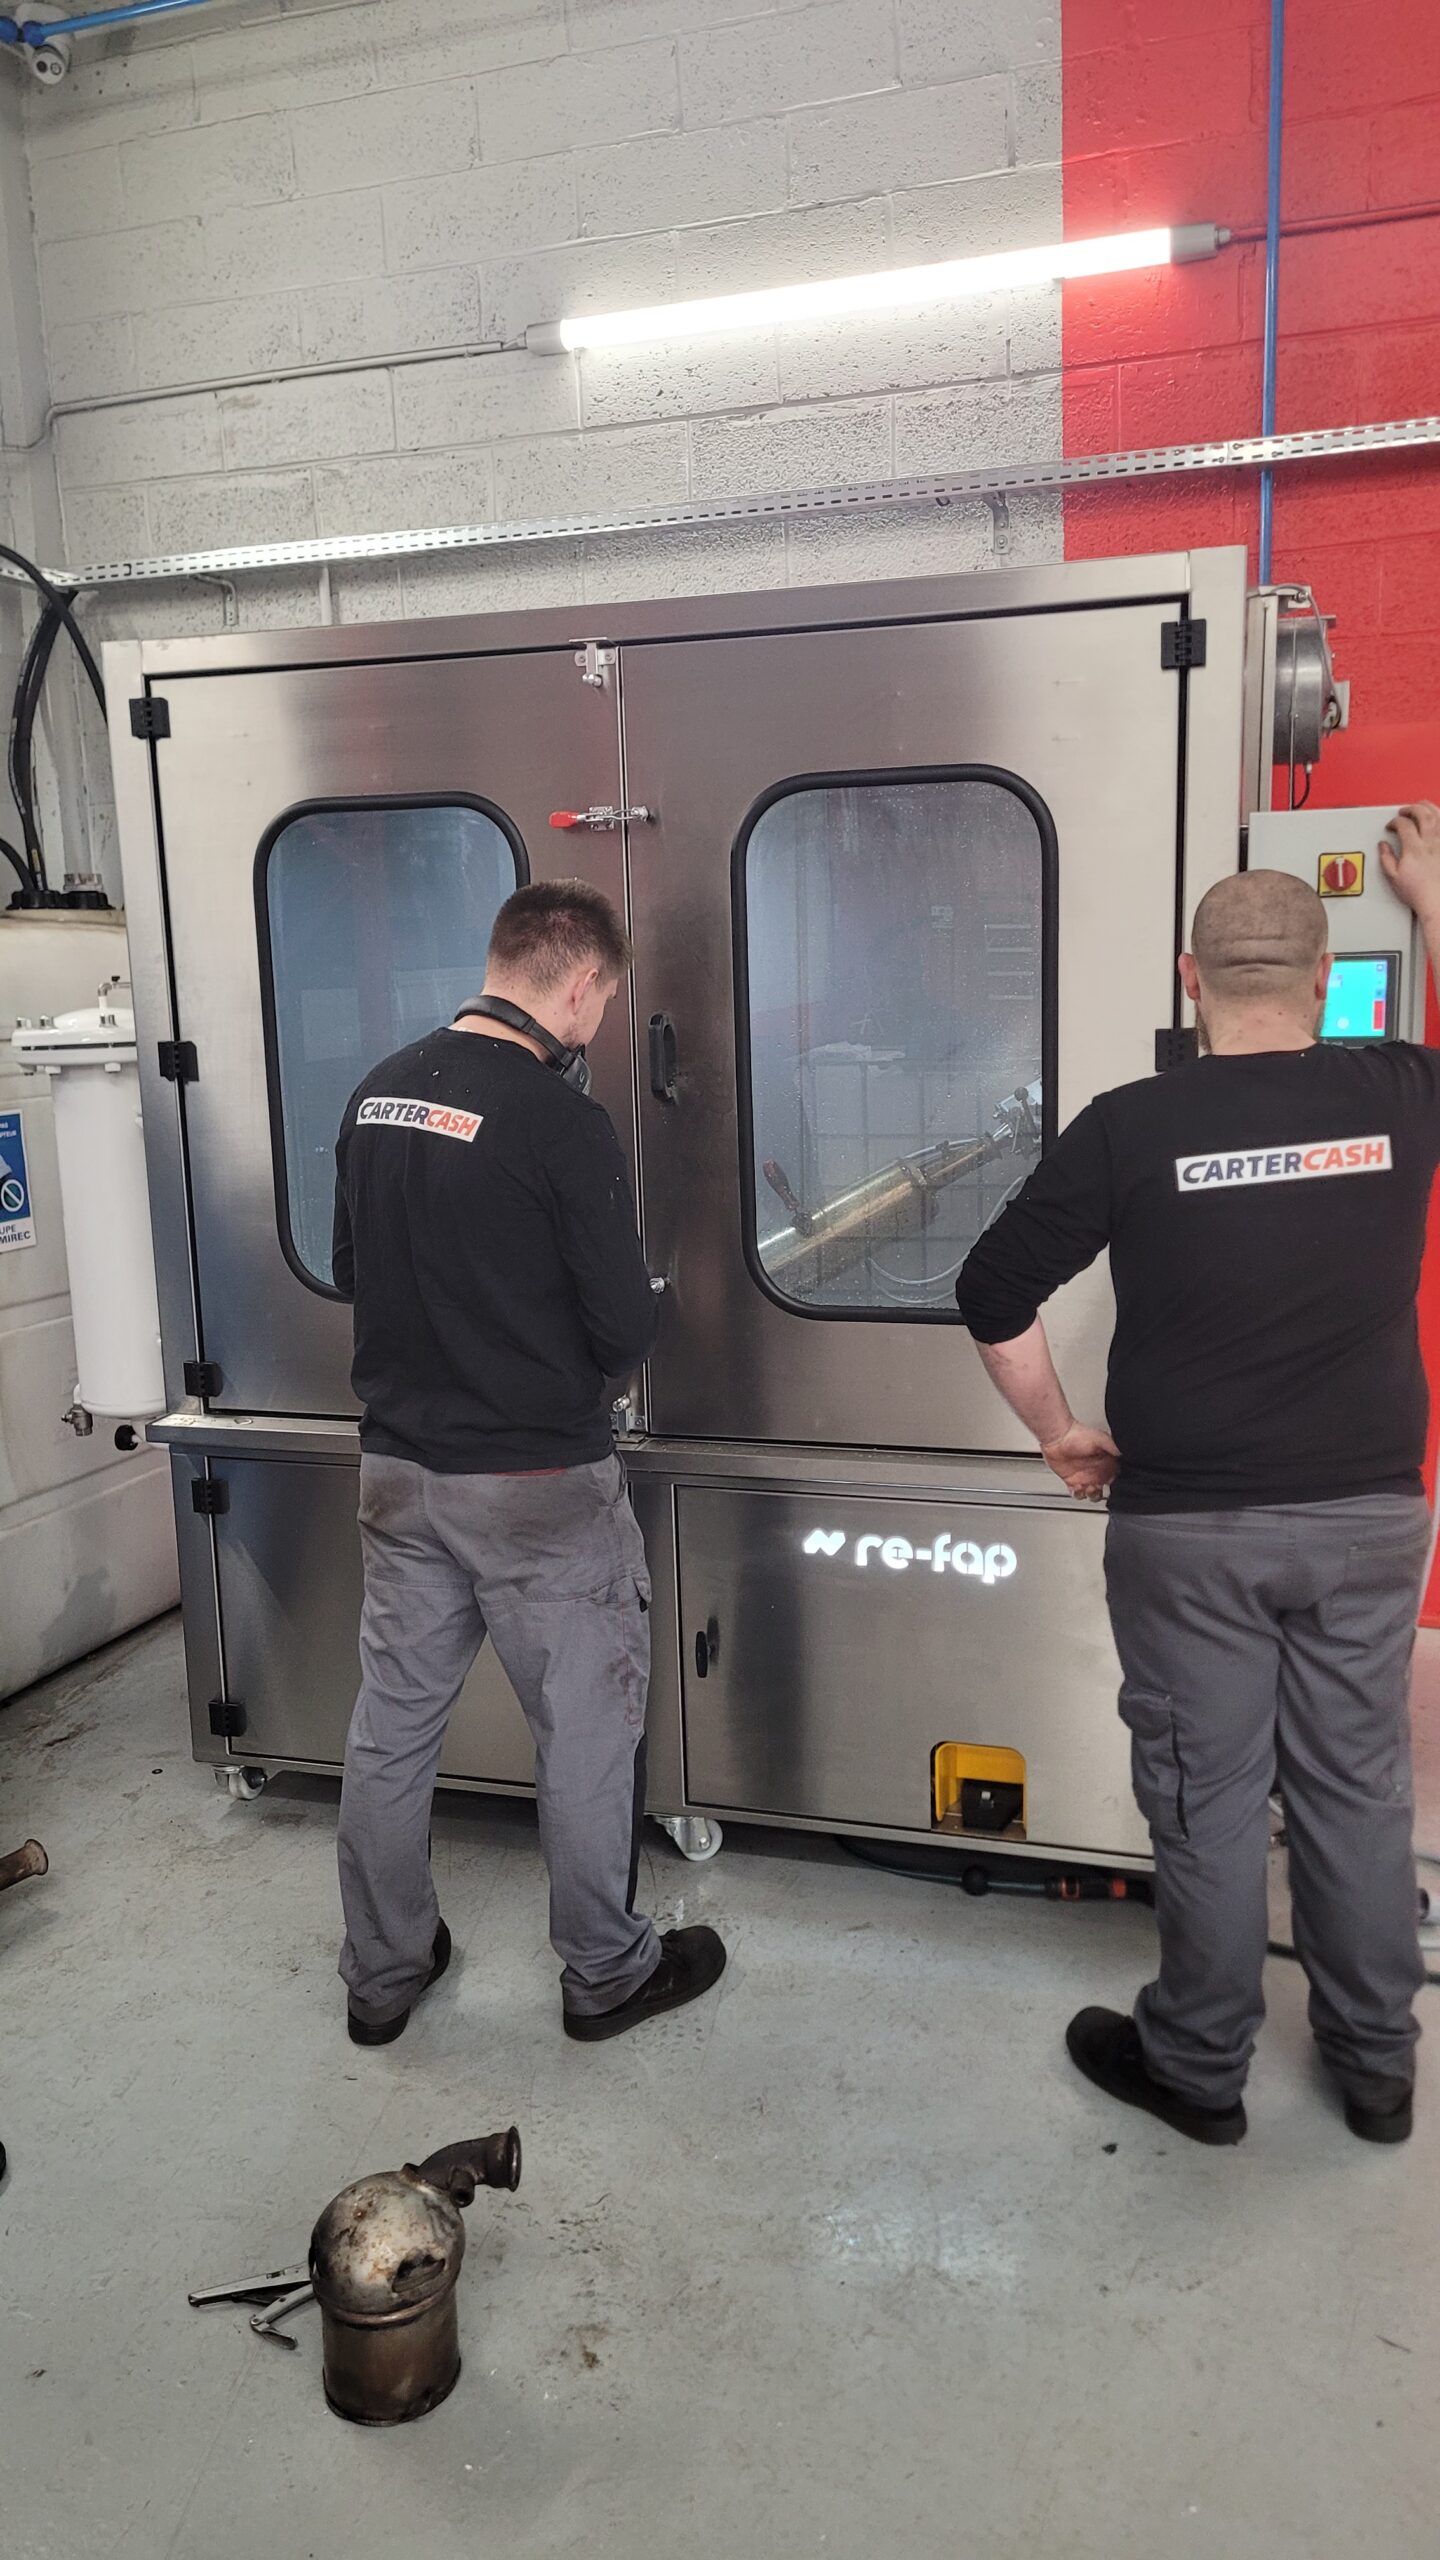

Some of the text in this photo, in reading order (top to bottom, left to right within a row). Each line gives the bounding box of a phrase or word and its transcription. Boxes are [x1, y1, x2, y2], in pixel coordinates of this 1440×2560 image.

[359, 1101, 479, 1137] CARTERCASH
[1182, 1141, 1386, 1185] CARTERCASH
[855, 1531, 1019, 1585] re-fap
